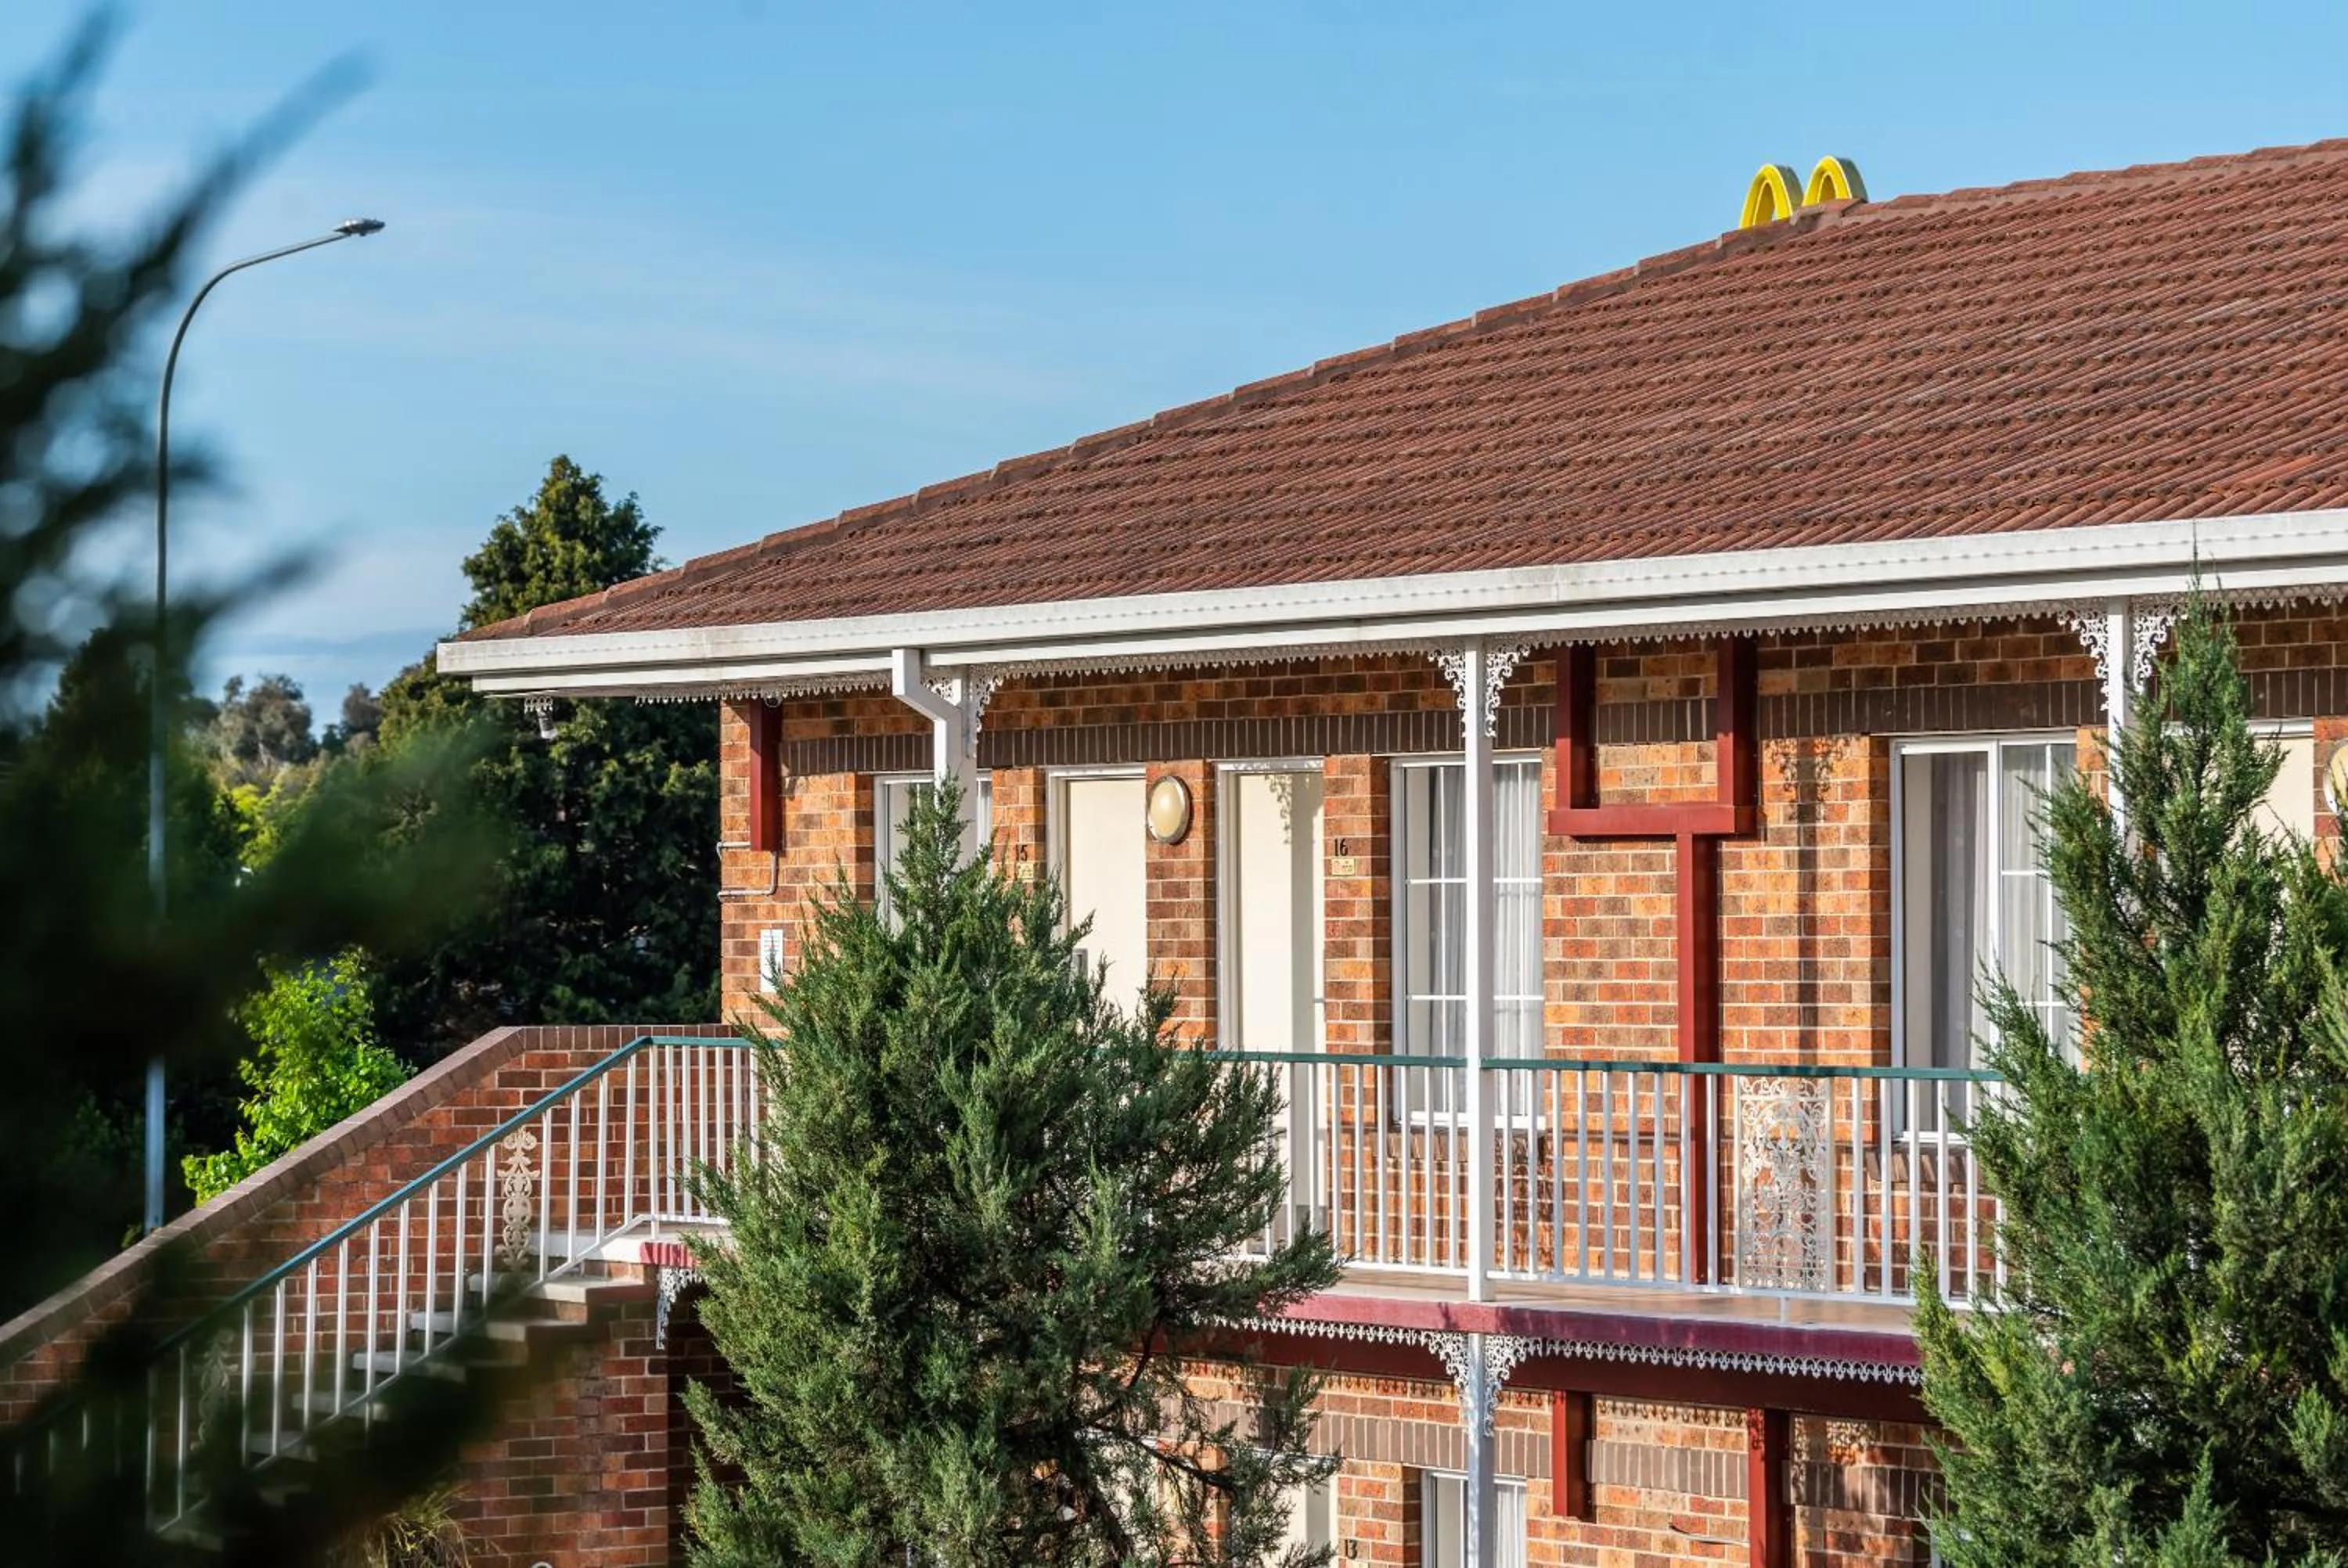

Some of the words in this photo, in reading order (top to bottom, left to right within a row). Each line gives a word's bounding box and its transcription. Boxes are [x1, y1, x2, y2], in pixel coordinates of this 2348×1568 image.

[1015, 844, 1028, 861] 15
[1334, 838, 1348, 857] 16
[1345, 1539, 1358, 1559] 13
